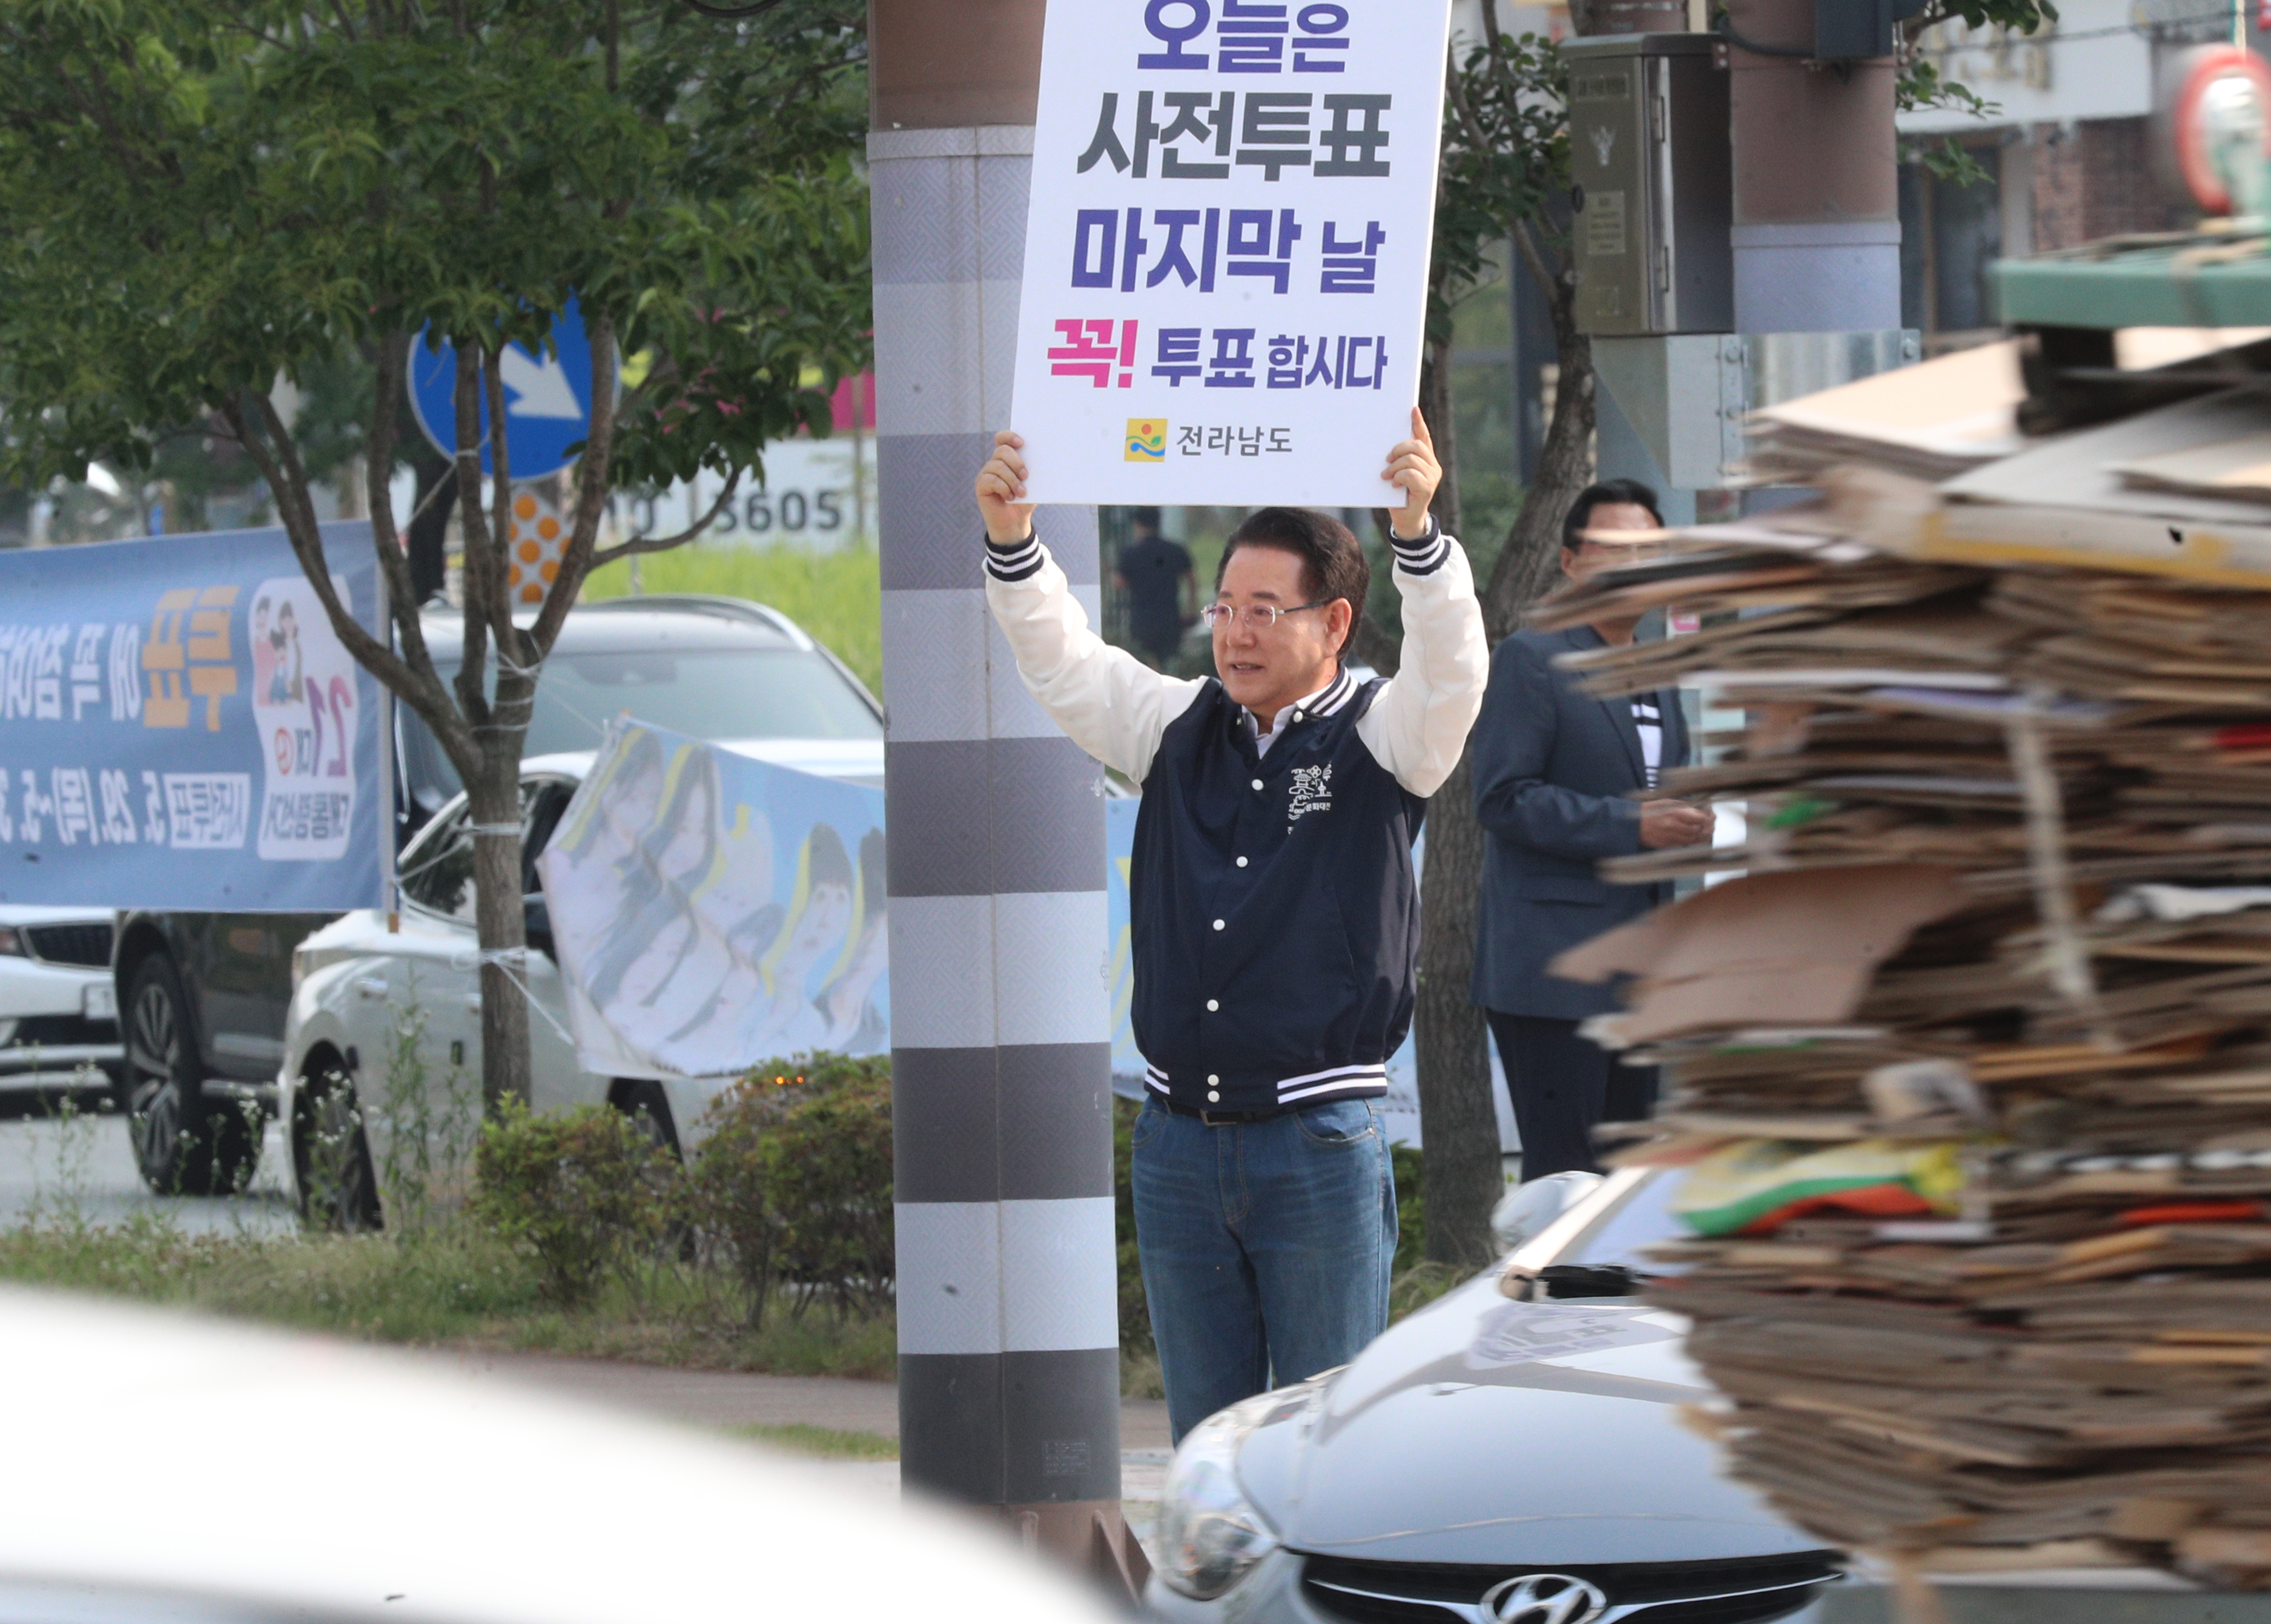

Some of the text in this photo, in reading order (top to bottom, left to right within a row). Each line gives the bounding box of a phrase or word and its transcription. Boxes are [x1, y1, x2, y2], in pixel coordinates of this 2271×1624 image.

[1137, 0, 1350, 73] 오늘은
[1077, 91, 1392, 182] 사전투표
[1071, 208, 1386, 294] 마지막 날
[1047, 319, 1388, 391] 꼭! 투표 합시다
[1176, 424, 1293, 457] 전라남도
